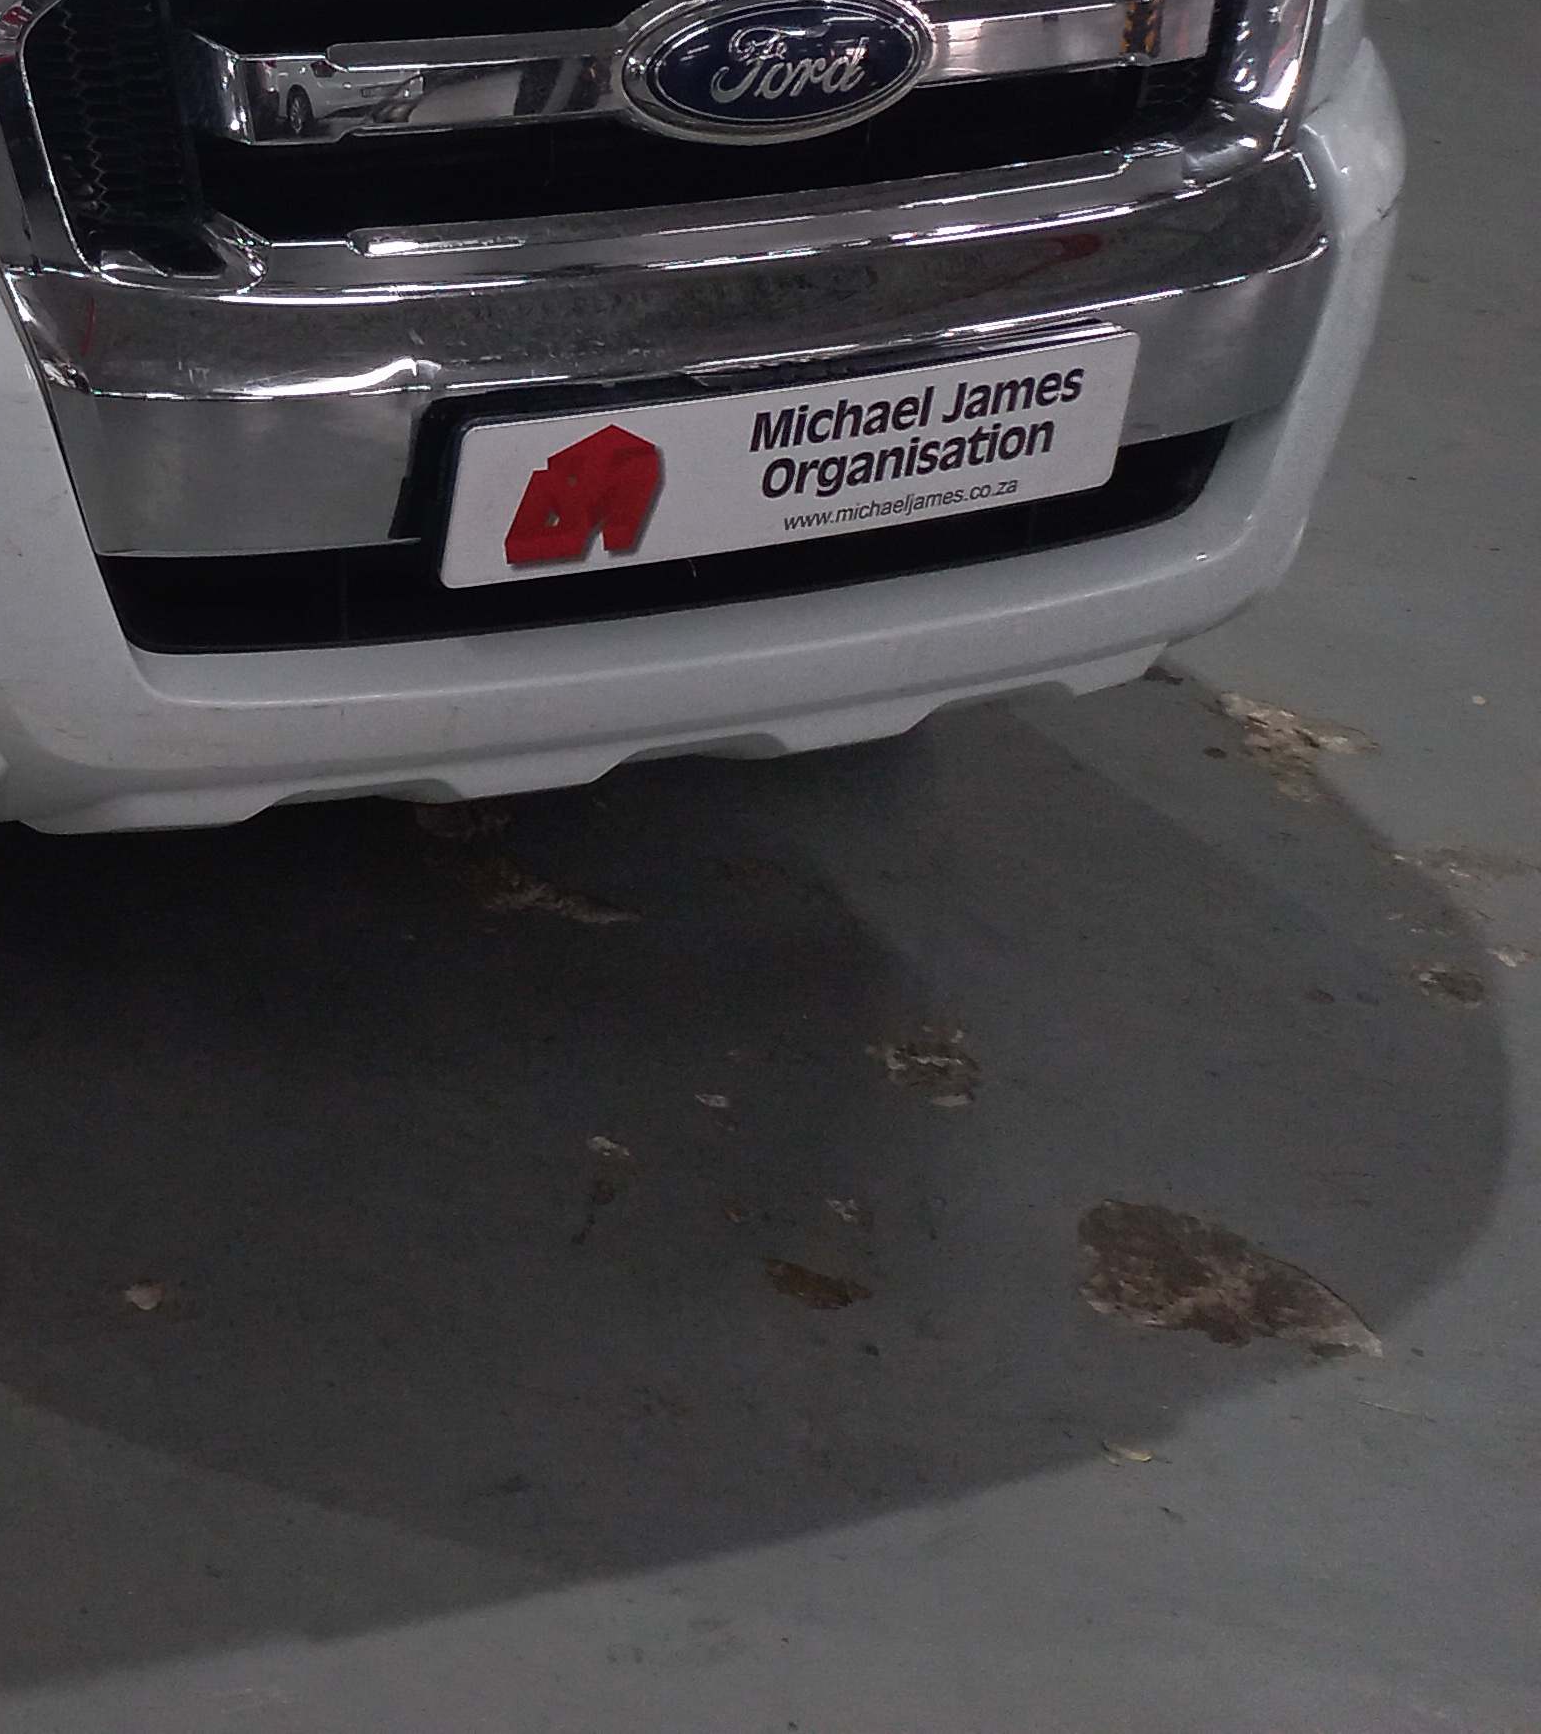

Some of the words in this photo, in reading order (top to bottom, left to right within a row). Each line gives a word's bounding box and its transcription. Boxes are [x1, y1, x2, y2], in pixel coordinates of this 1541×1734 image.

[711, 24, 870, 104] Ford
[748, 385, 935, 453] Michael
[941, 367, 1085, 424] James
[760, 418, 1056, 499] Organisation
[784, 479, 1019, 531] www.michaeljames.co.za
